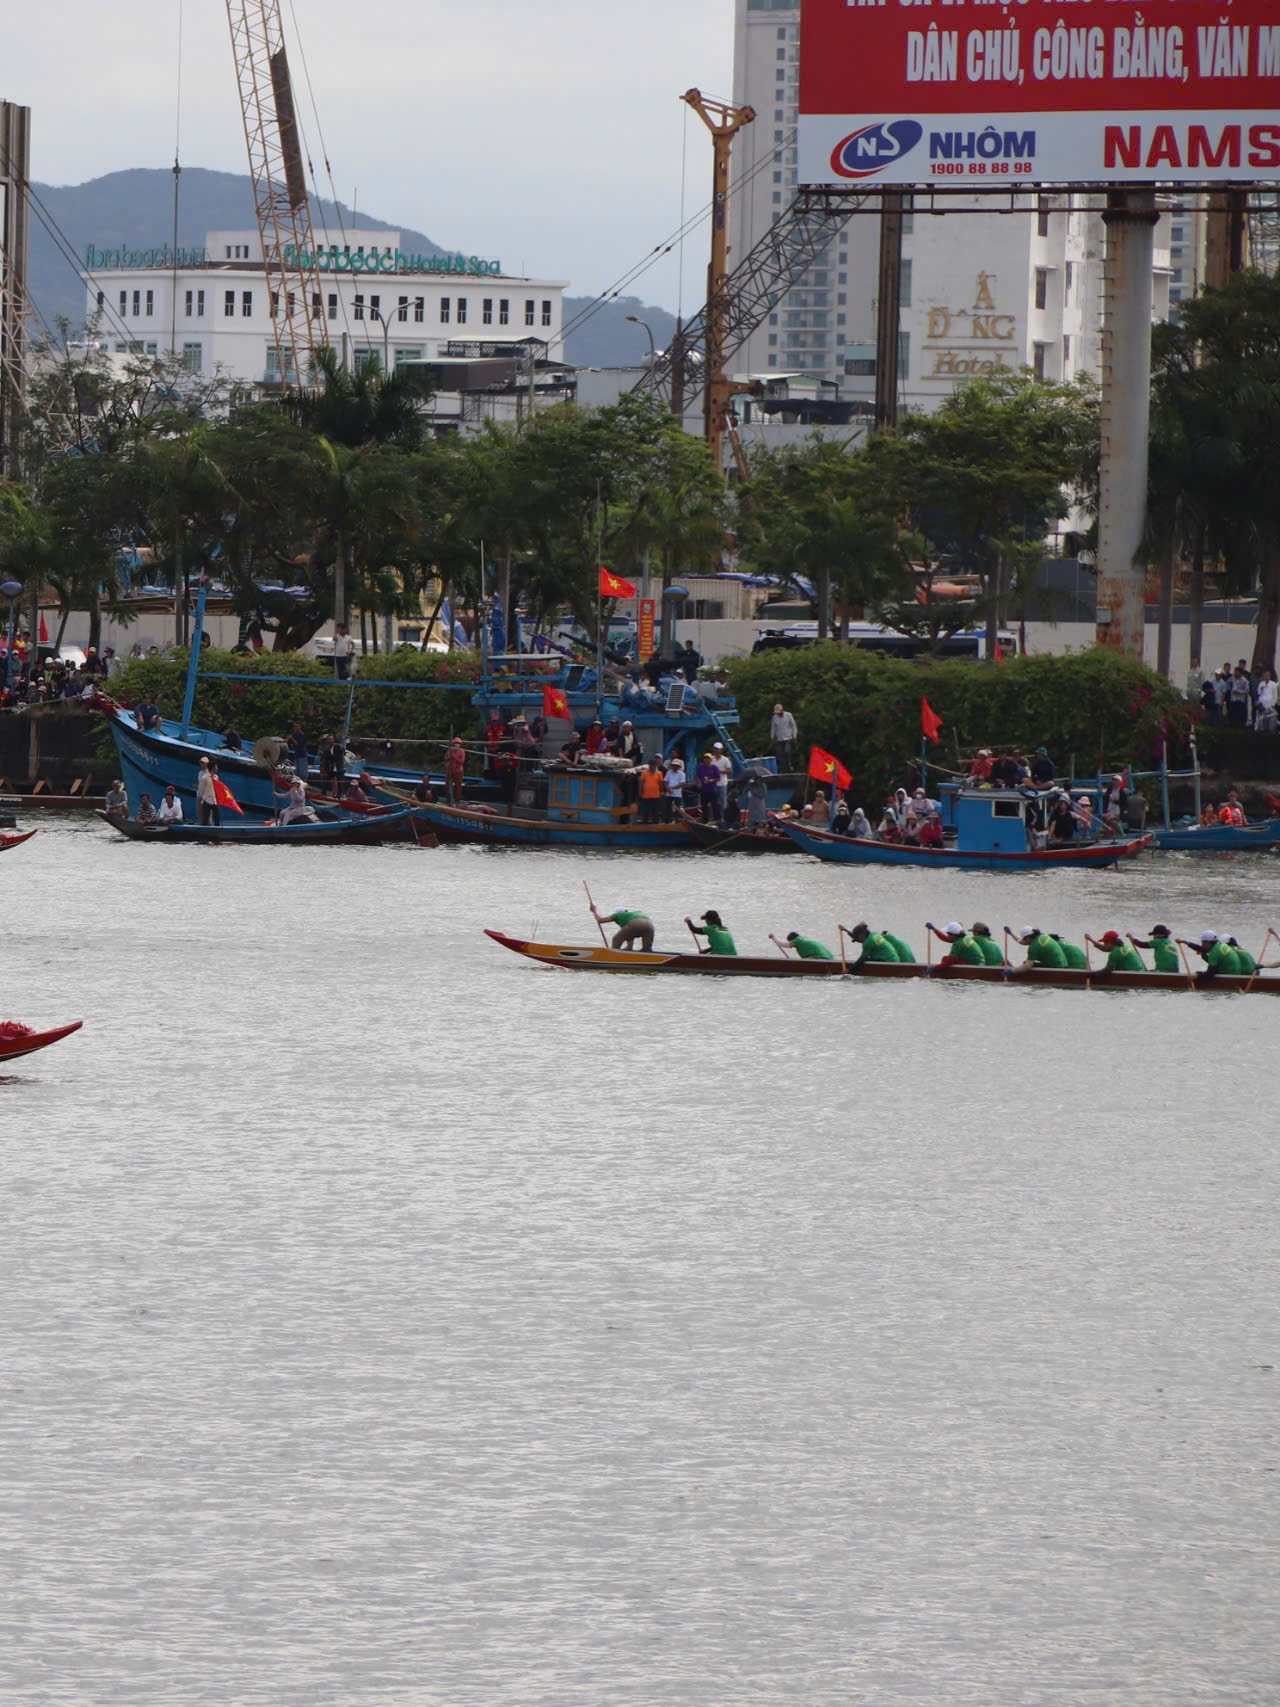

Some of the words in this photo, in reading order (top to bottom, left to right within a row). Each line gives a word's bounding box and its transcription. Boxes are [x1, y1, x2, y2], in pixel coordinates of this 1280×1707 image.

[906, 21, 959, 82] DÂN
[966, 17, 1024, 86] CHỦ,
[1033, 19, 1105, 80] CÔNG
[1113, 11, 1189, 83] BẰNG,
[1197, 16, 1250, 78] VĂN
[929, 125, 1036, 159] NHÔM
[1104, 125, 1280, 168] NAMS
[930, 163, 964, 174] 1900
[968, 163, 986, 174] 88
[991, 162, 1009, 174] 88
[1014, 162, 1032, 173] 98
[410, 253, 451, 273] Hotel
[454, 251, 466, 273] &
[468, 255, 502, 278] Spa
